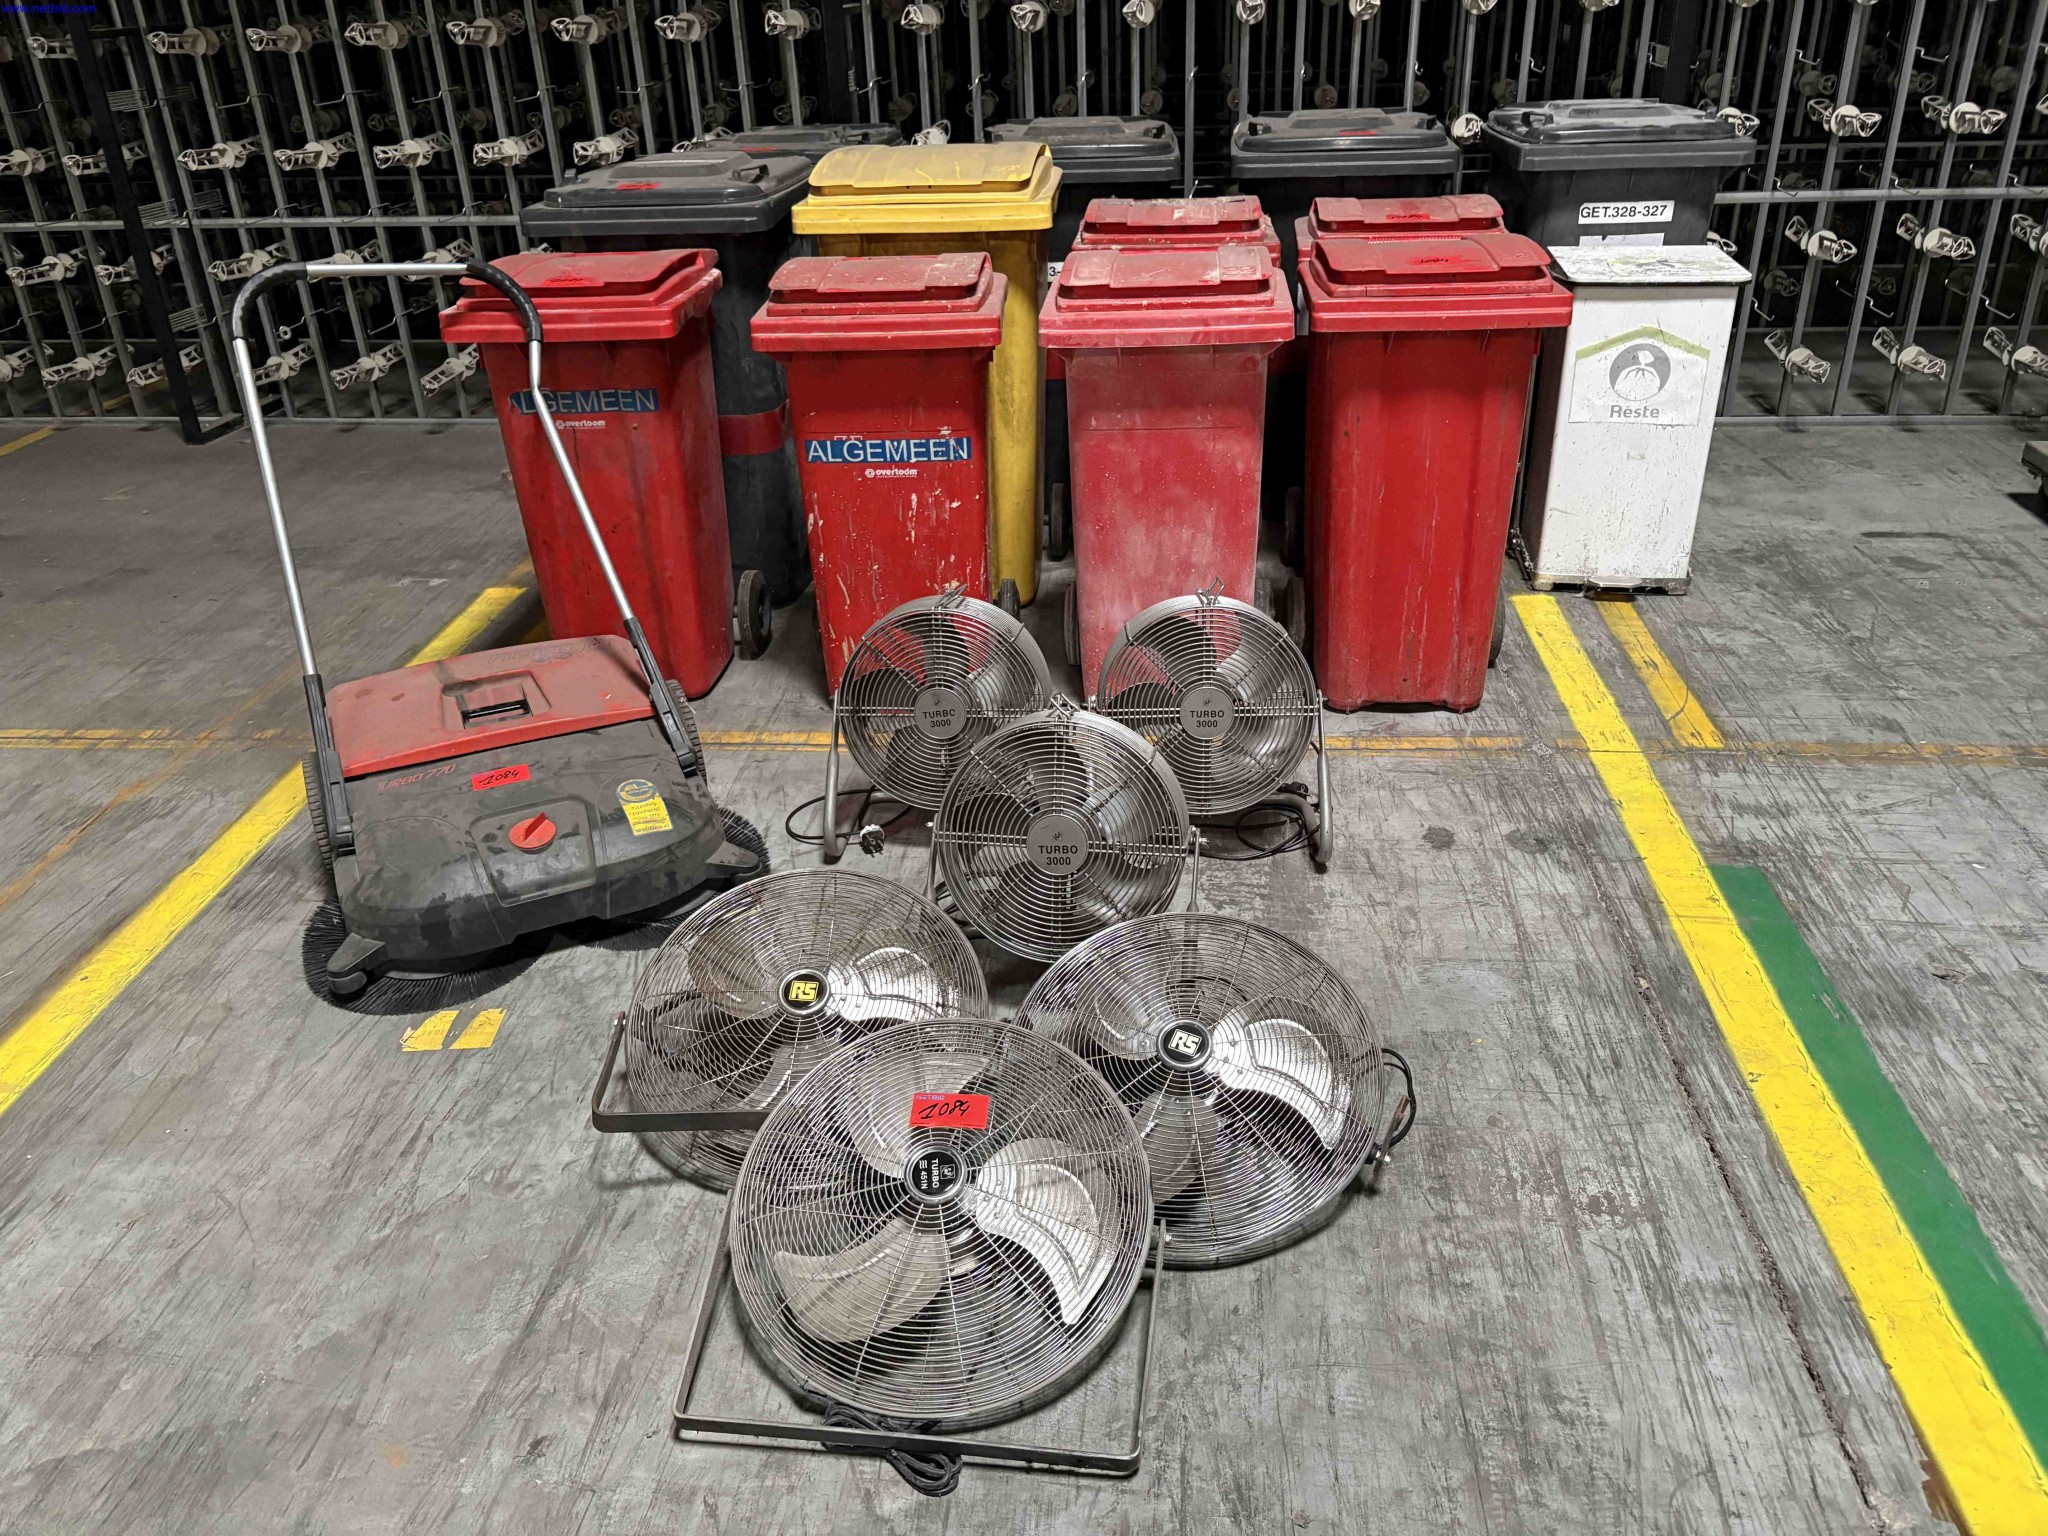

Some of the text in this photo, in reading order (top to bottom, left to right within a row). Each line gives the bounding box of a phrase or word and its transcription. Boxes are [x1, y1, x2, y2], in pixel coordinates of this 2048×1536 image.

[1580, 204, 1668, 219] GET.328-327
[807, 437, 968, 463] ALGEMEEN
[875, 468, 918, 476] overtoom
[1190, 710, 1225, 718] TURBO
[930, 719, 952, 728] 3000
[1195, 720, 1218, 728] 3000
[425, 763, 457, 779] 770
[478, 769, 520, 786] 1084
[1038, 845, 1078, 855] TURBO
[1046, 856, 1071, 866] 3000
[790, 982, 818, 1000] RS
[1169, 1030, 1201, 1056] RS
[918, 1099, 971, 1120] 1084
[931, 1158, 940, 1188] TURBO
